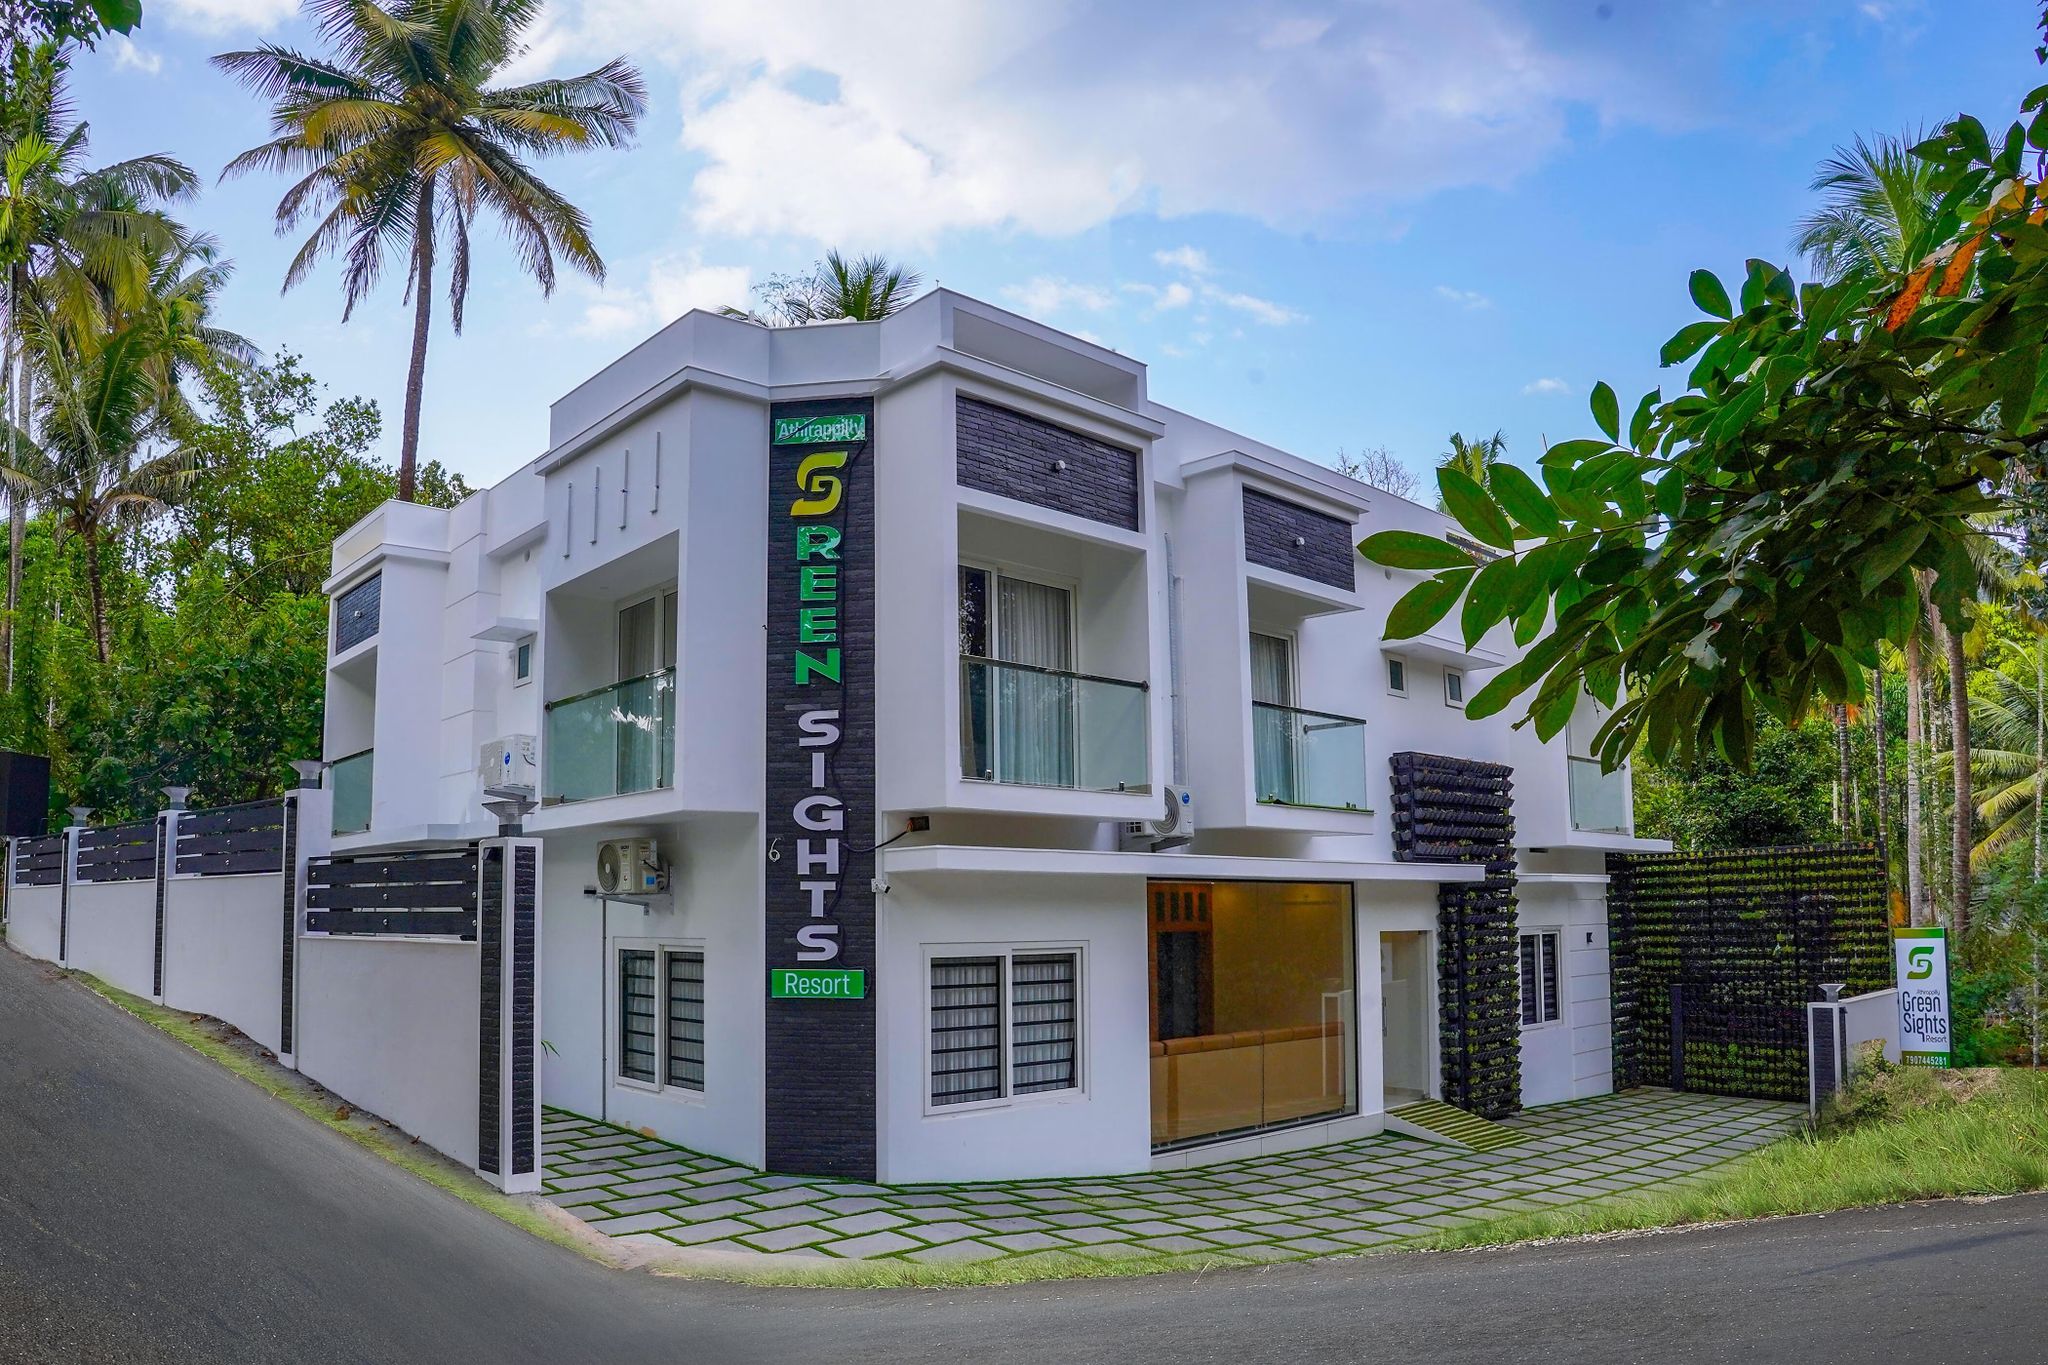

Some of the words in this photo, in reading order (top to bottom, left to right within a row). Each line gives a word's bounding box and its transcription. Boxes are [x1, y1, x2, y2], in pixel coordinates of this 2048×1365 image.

[793, 709, 844, 962] SIGHTS
[785, 973, 850, 995] Resort
[1902, 991, 1941, 1013] Green
[1903, 1013, 1947, 1042] Sights
[1925, 1035, 1947, 1043] Resort
